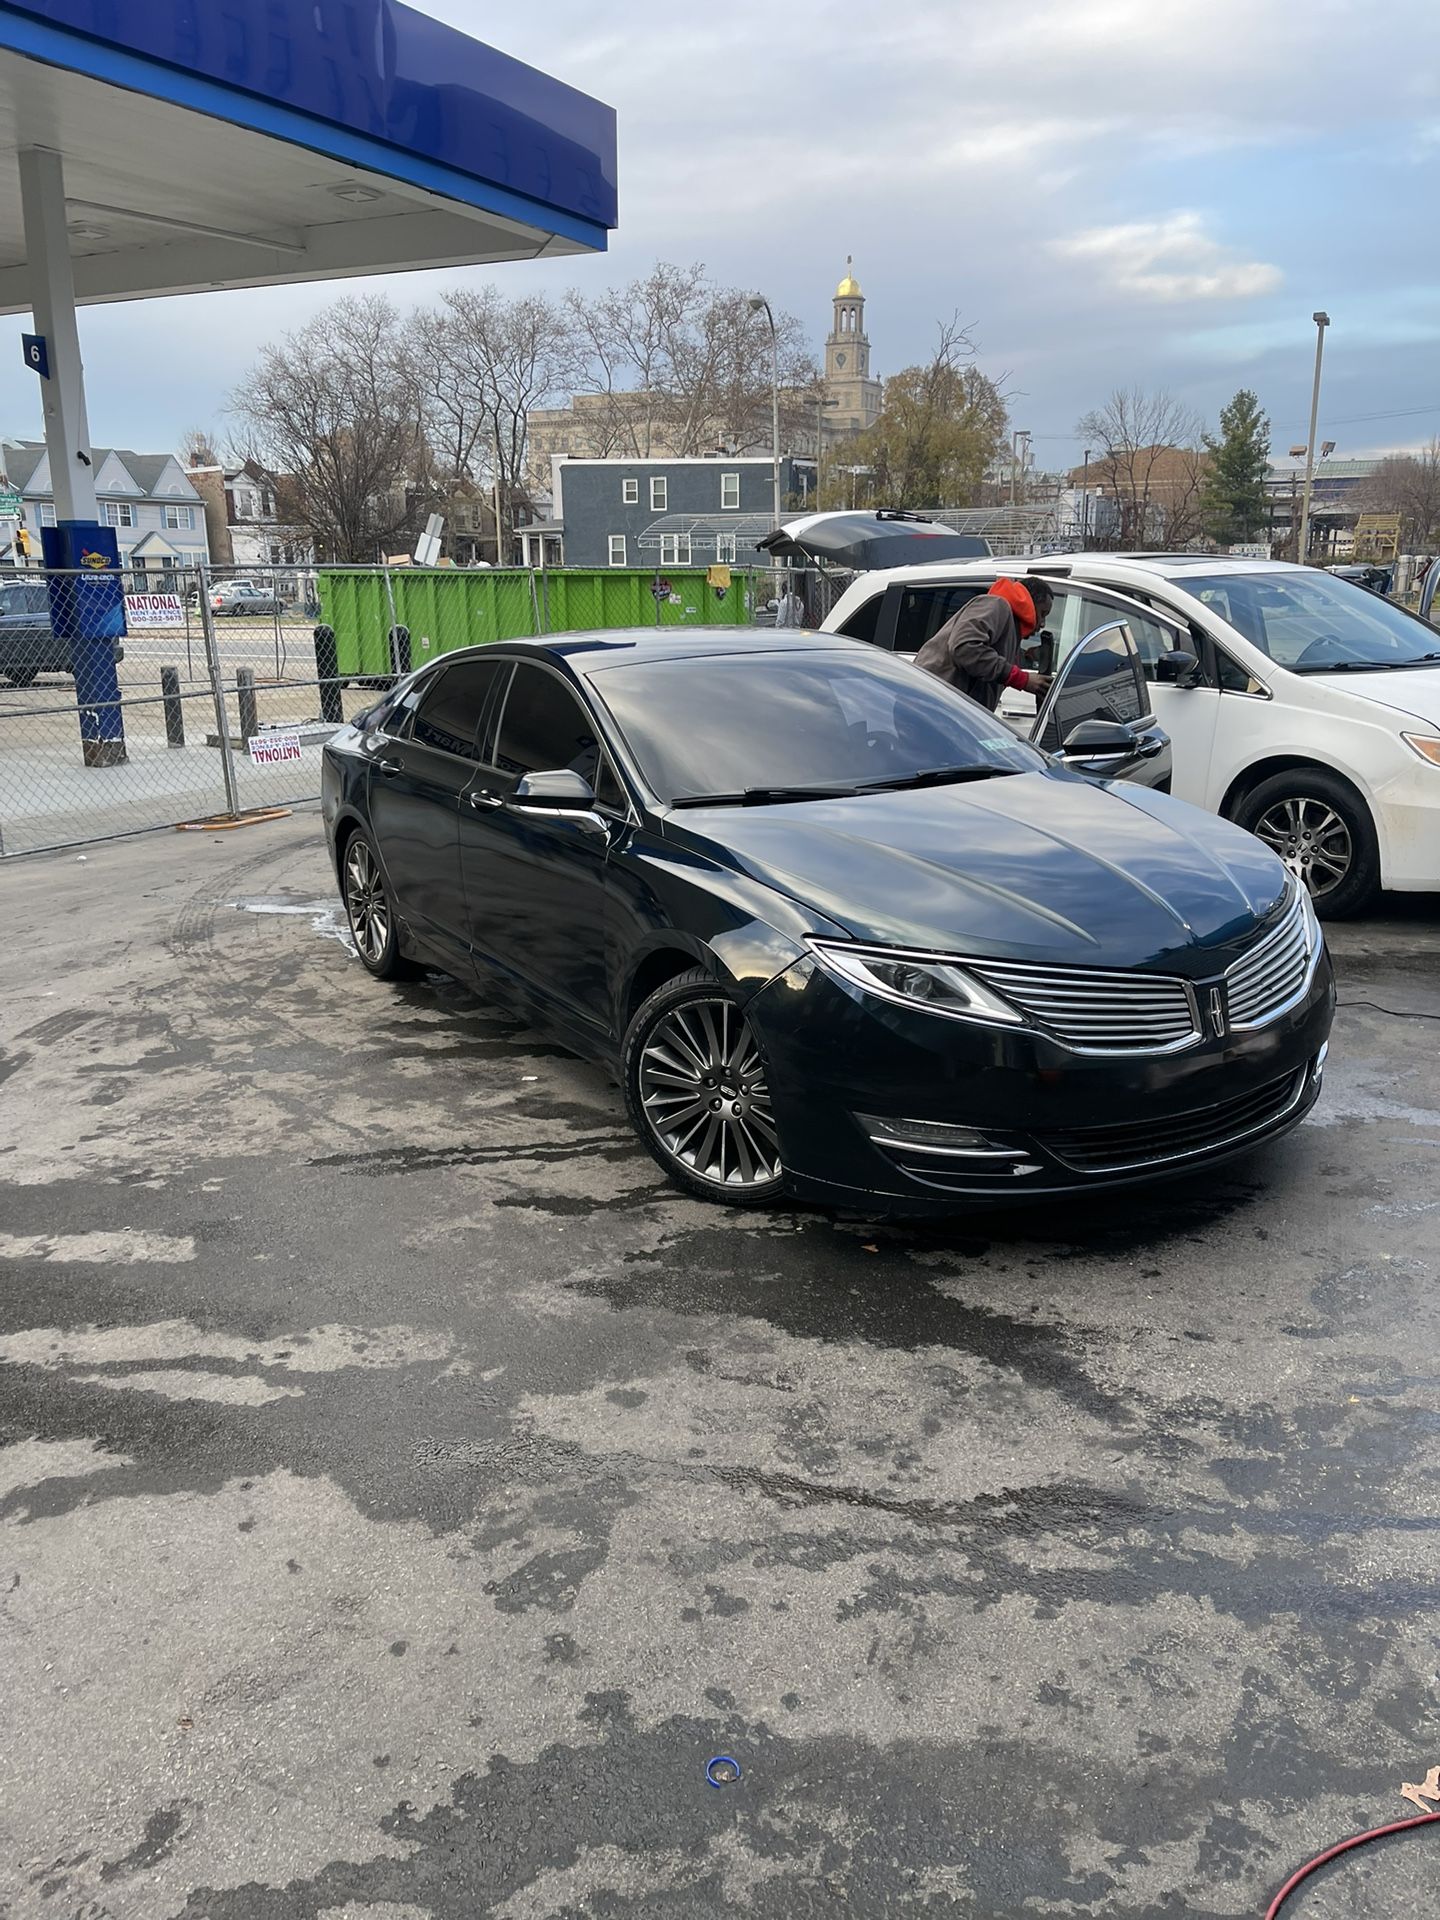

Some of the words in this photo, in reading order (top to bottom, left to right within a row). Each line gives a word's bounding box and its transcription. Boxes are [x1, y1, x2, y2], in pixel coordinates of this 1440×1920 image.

[31, 345, 40, 362] 6
[82, 556, 110, 564] SUNOCO
[127, 596, 180, 610] NATIONAL
[252, 746, 300, 763] NATIONAL
